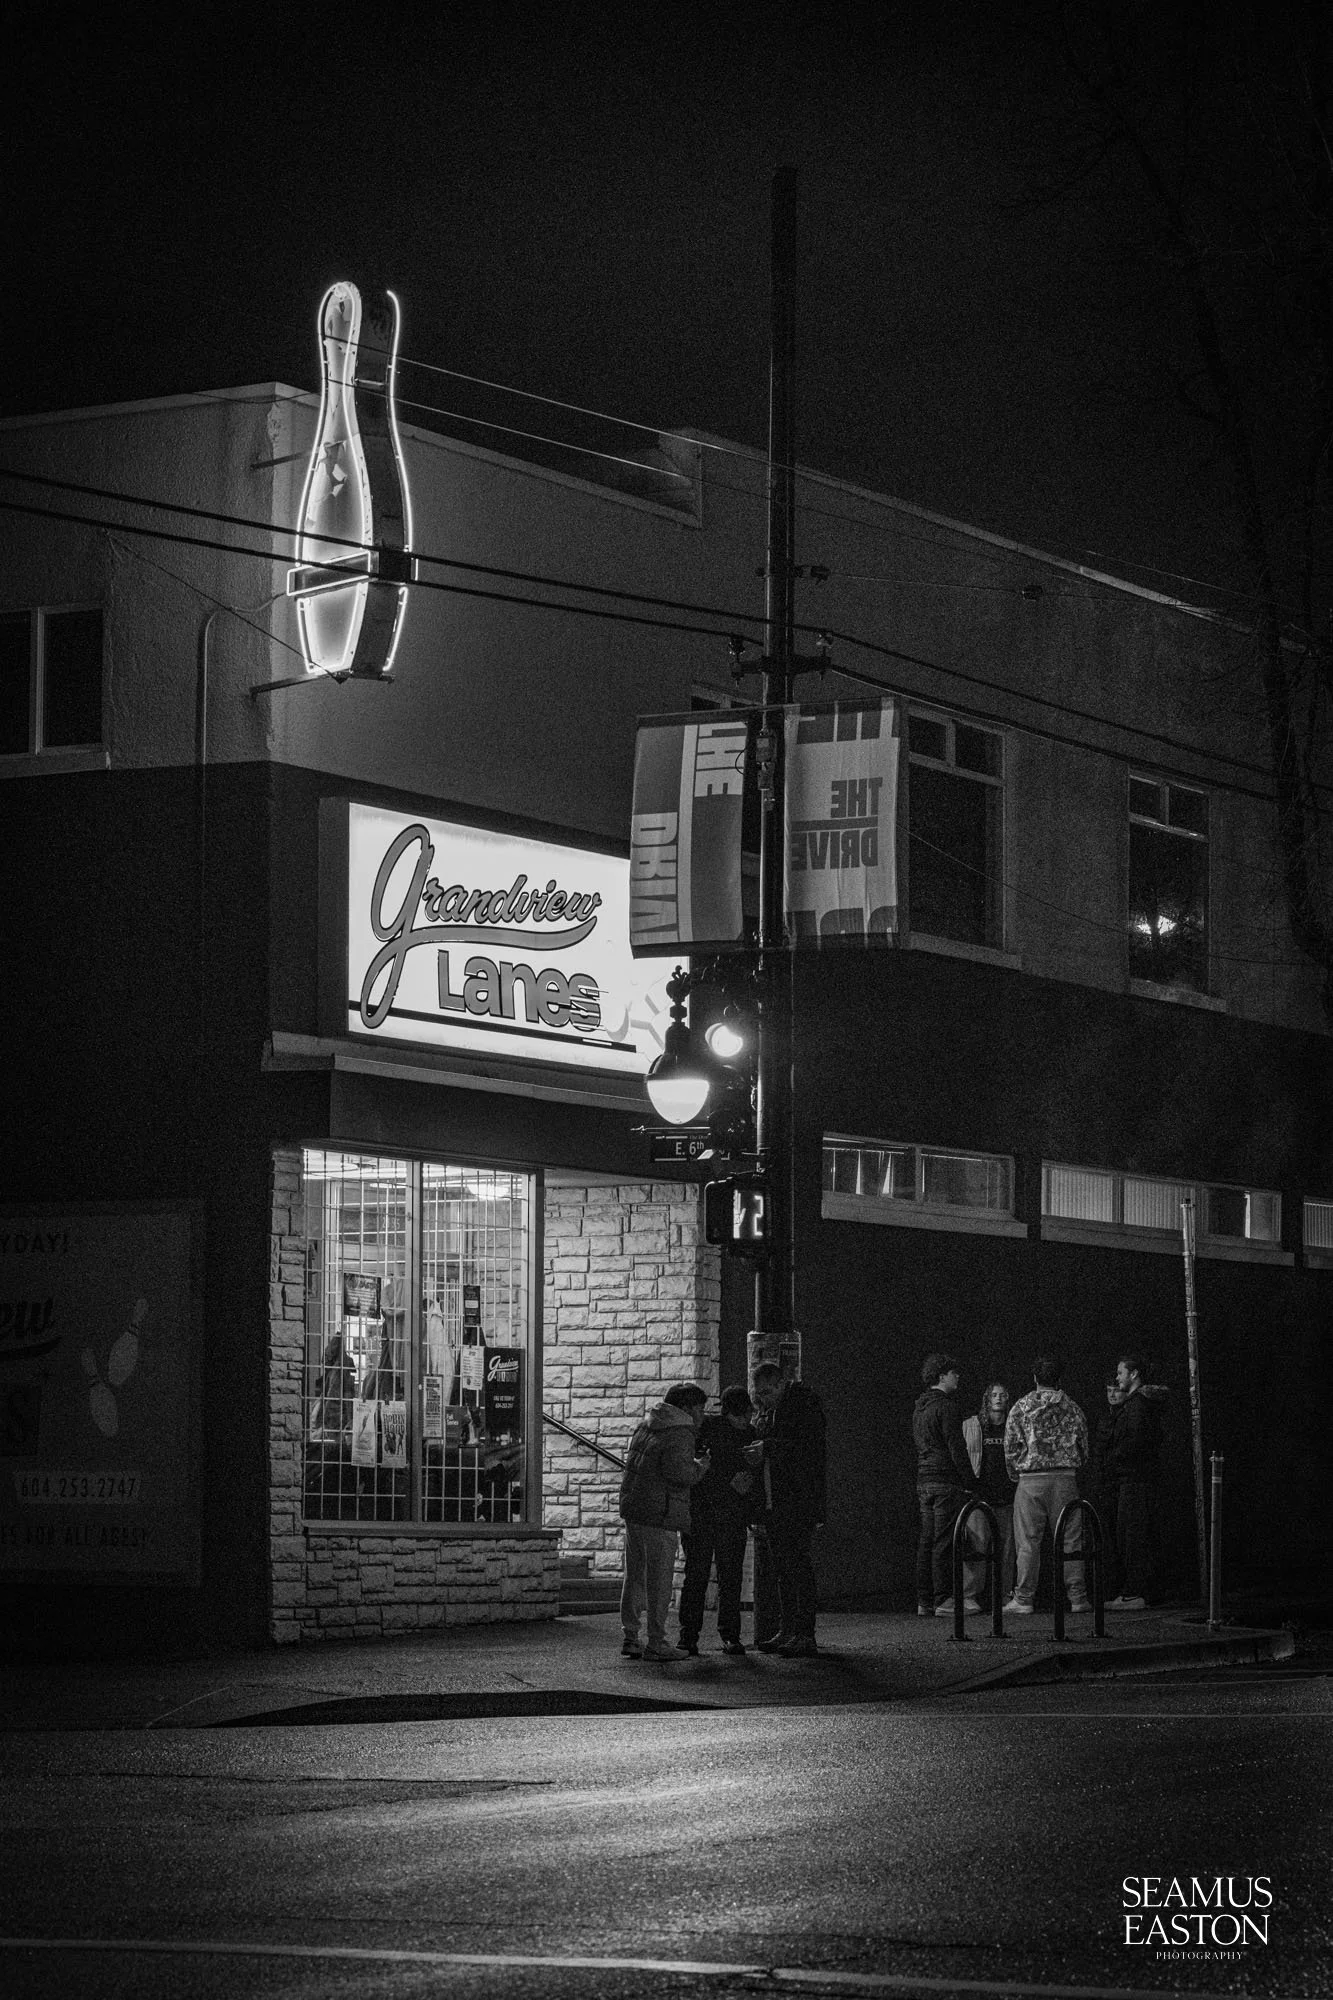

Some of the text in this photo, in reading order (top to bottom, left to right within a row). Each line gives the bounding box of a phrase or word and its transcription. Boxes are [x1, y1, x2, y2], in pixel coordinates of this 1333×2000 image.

[437, 949, 602, 1031] Lanes
[675, 1141, 705, 1155] E. 6th
[20, 1477, 136, 1498] 604.253.2747
